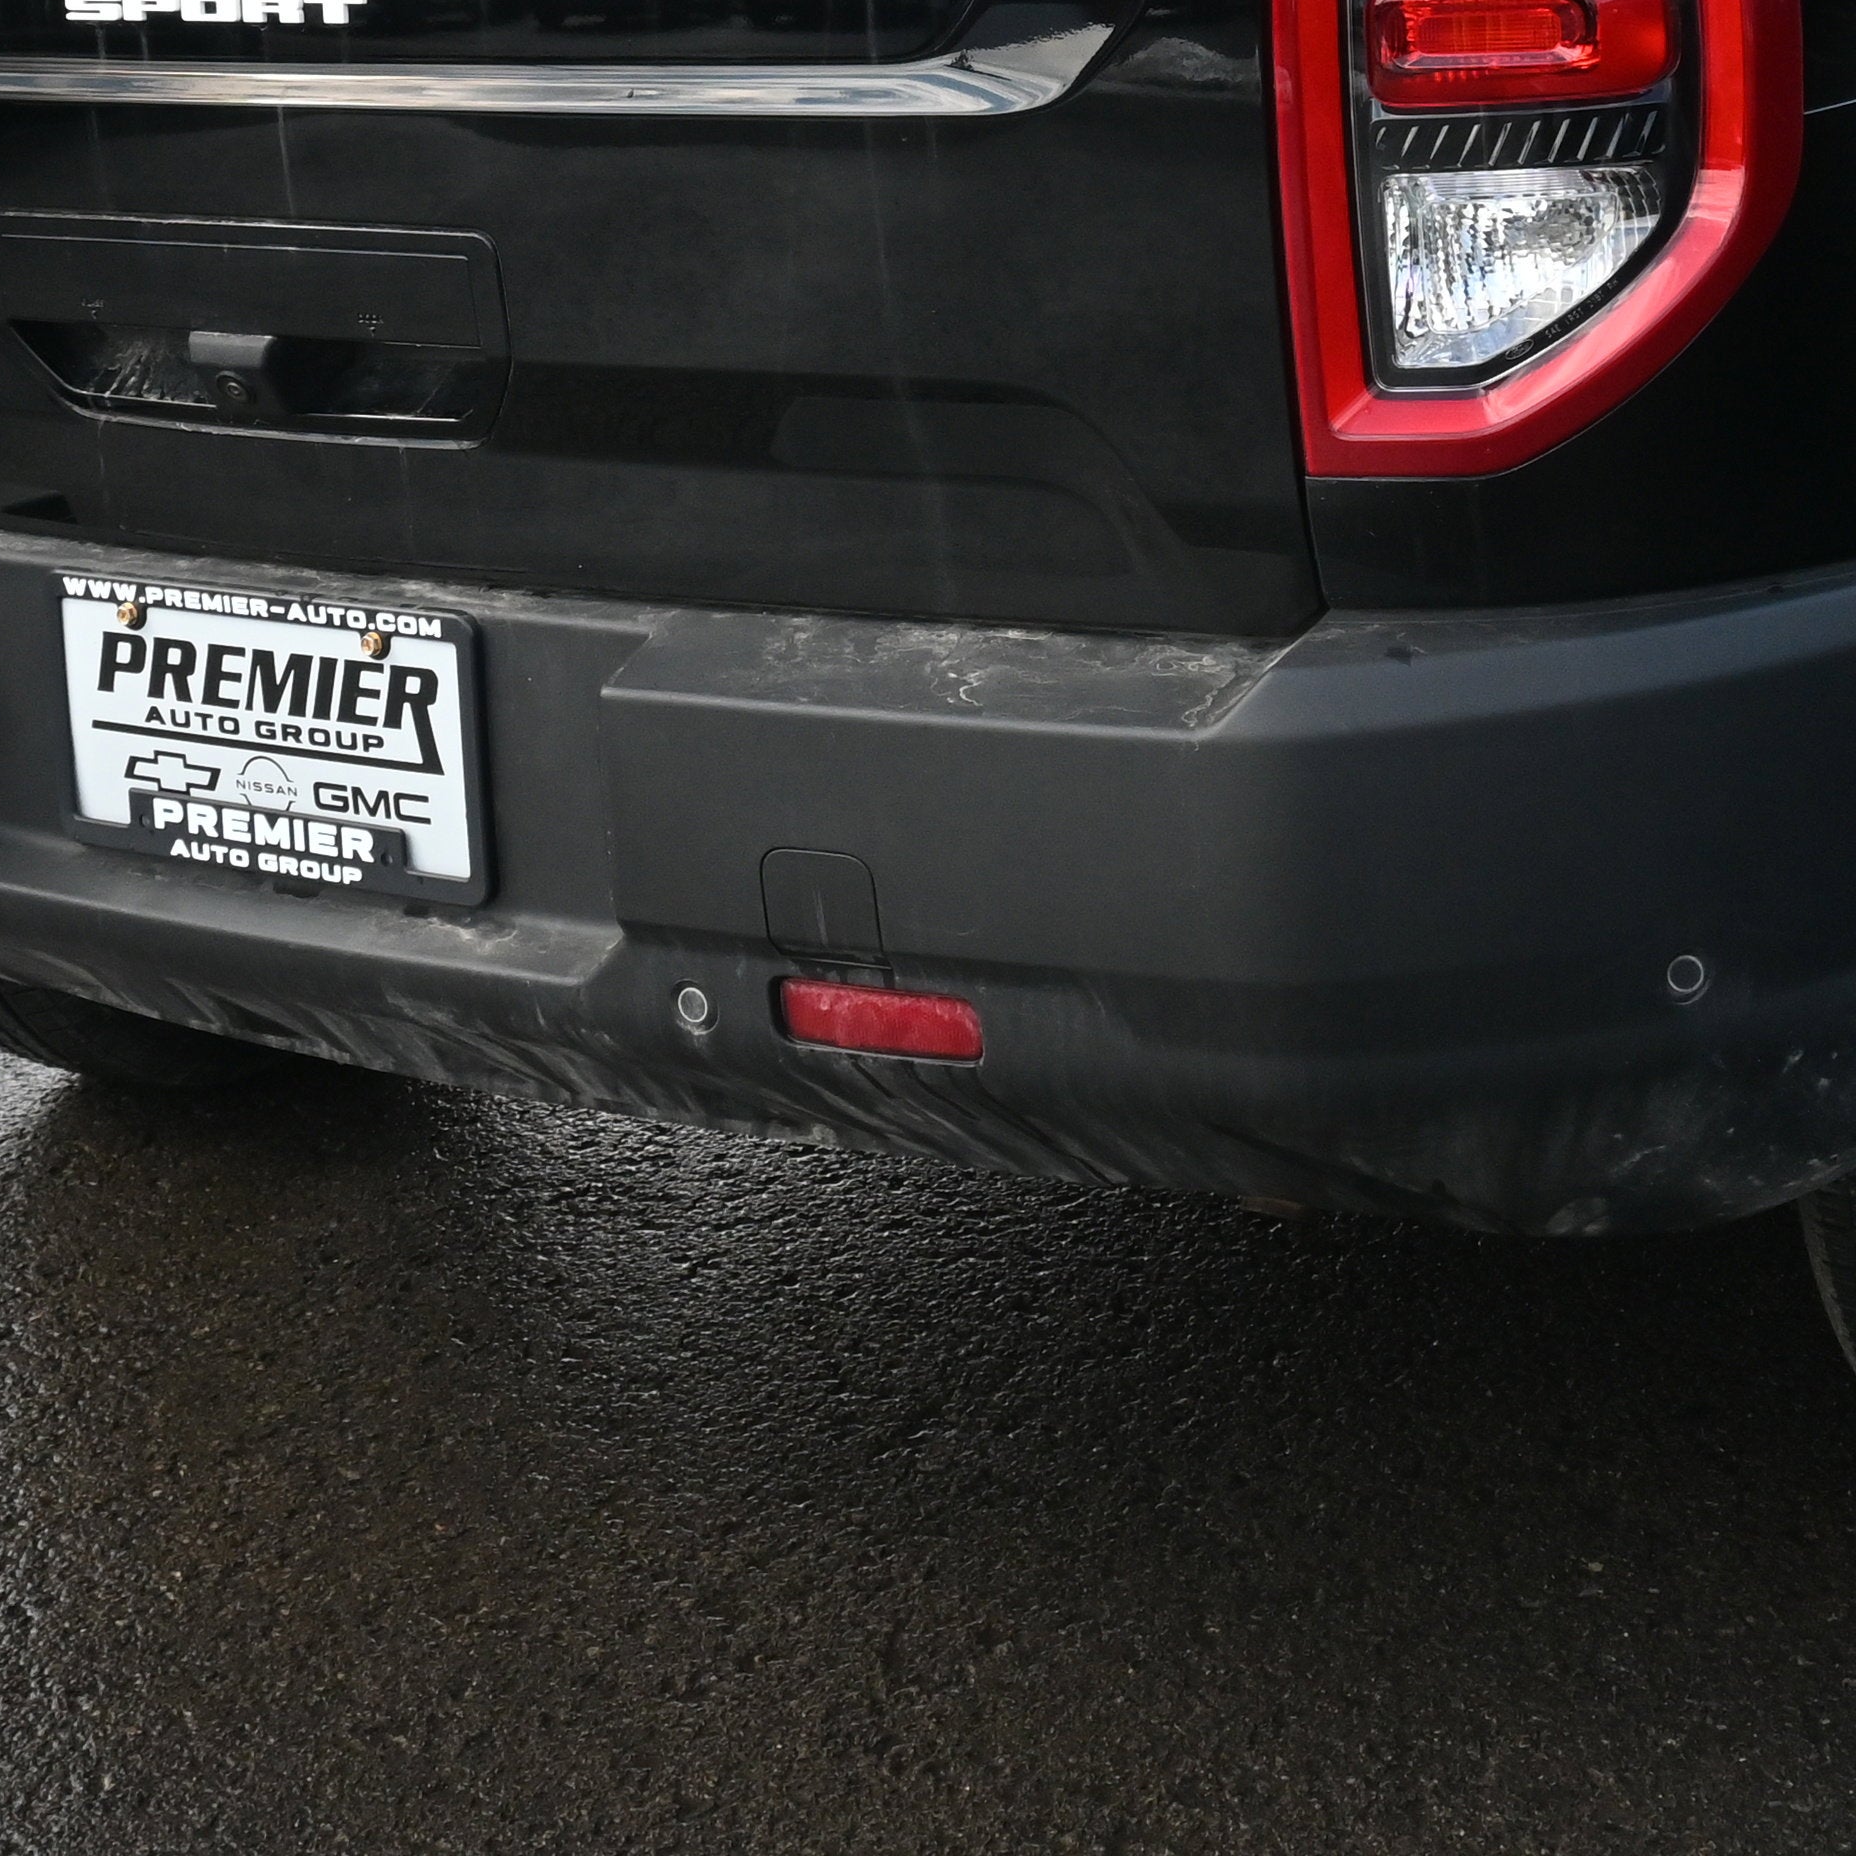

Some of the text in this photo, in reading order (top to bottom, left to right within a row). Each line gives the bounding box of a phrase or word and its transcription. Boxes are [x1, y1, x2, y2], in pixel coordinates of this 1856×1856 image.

[62, 576, 442, 639] WWW.PREMIER-AUTO.COM
[97, 631, 440, 748] PREMIER
[144, 705, 385, 753] AUTO GROUP
[236, 778, 298, 798] NISSAN
[313, 781, 432, 825] GMC
[152, 797, 376, 864] PREMIER
[170, 838, 363, 885] AUTO GROUP
